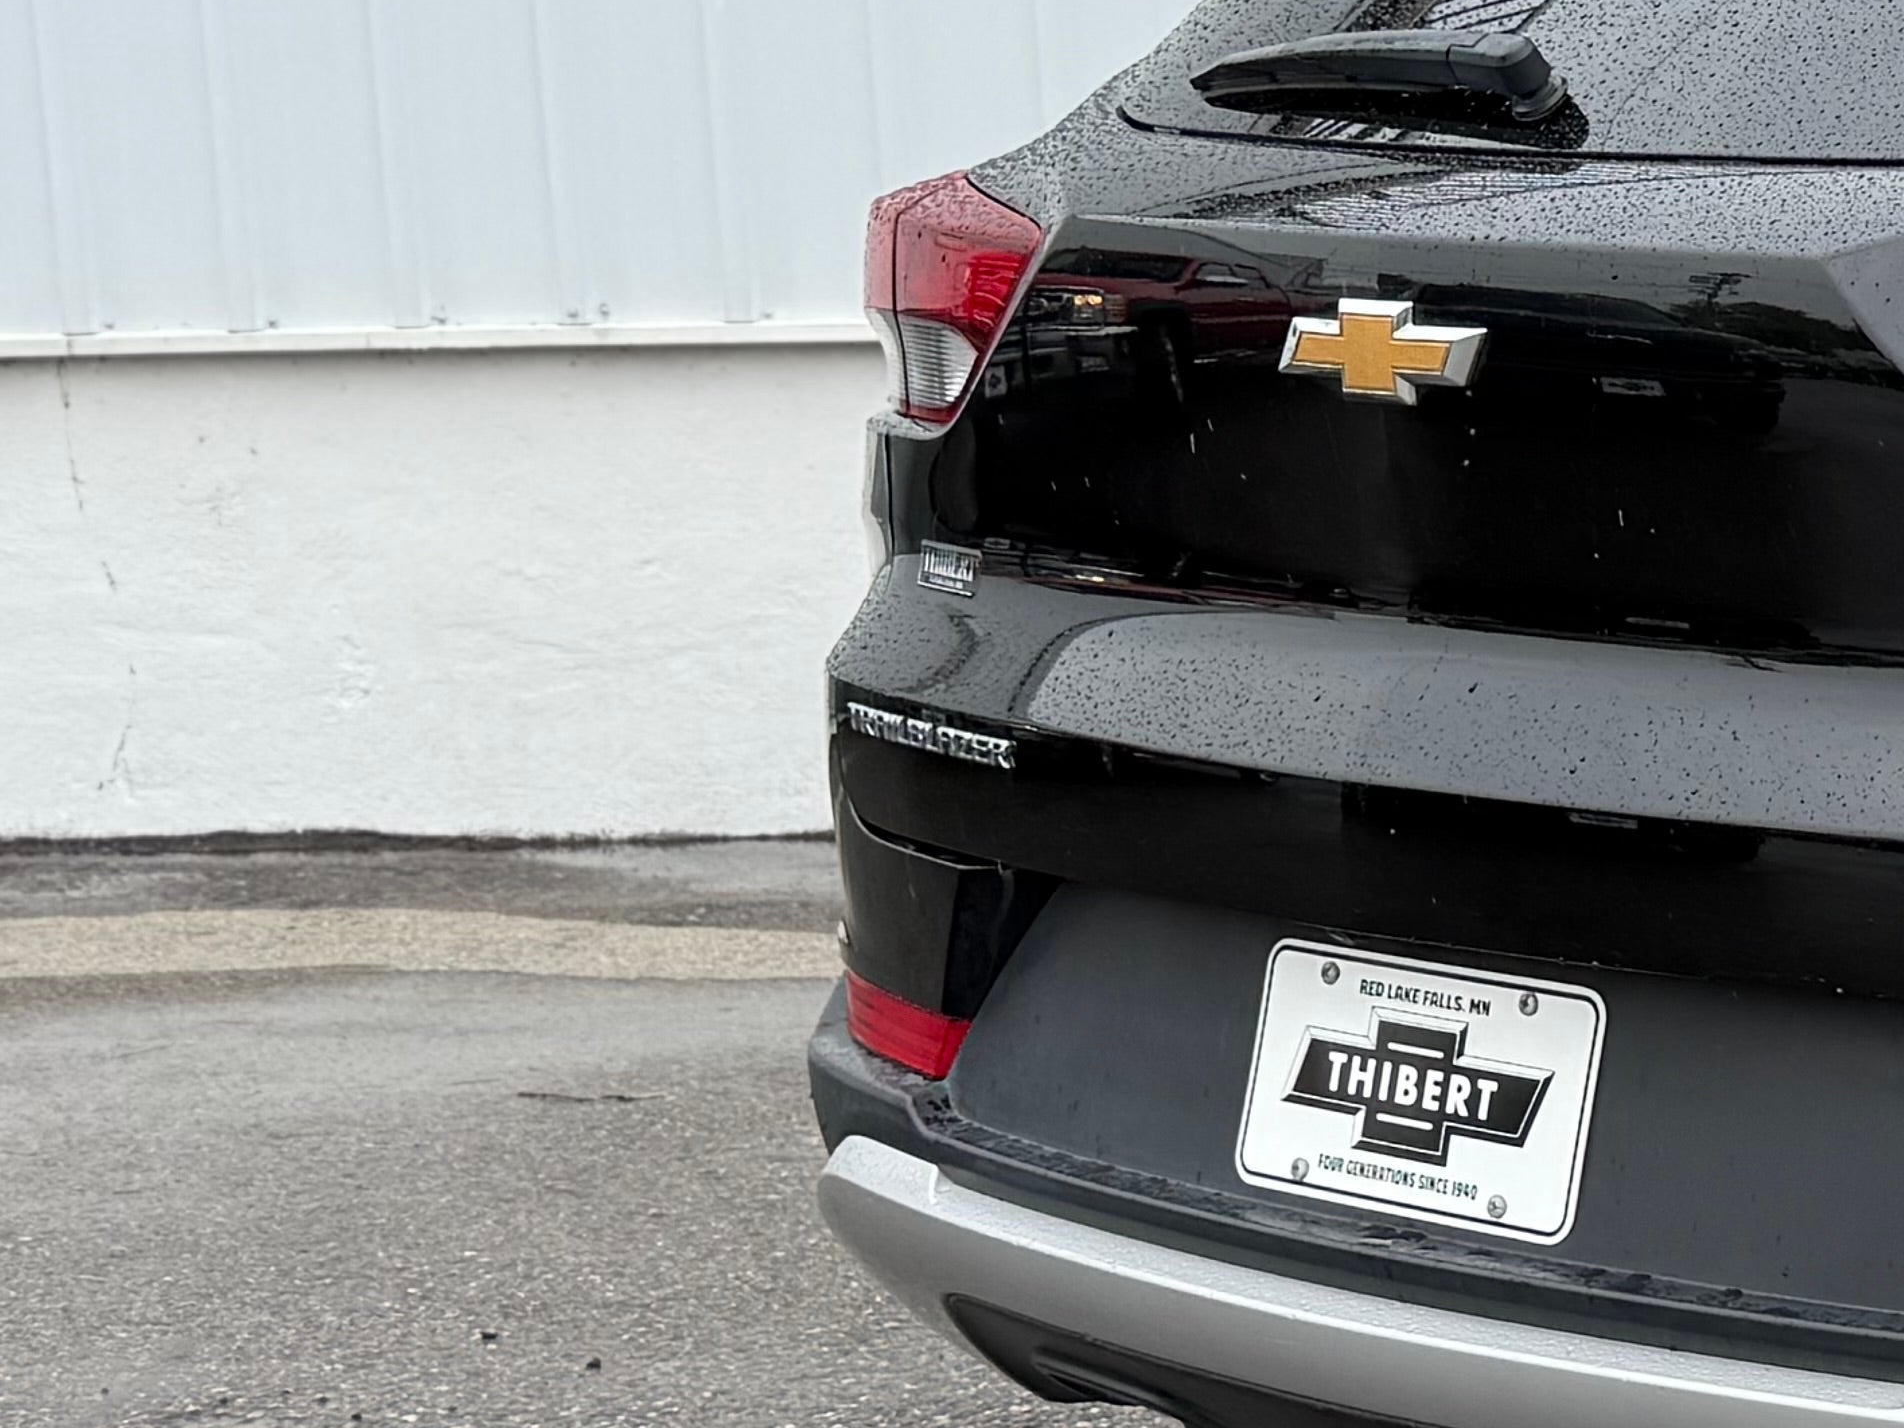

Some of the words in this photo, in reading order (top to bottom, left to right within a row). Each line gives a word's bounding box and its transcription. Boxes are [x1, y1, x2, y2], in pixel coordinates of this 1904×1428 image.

[1360, 978, 1385, 997] RED
[1387, 983, 1421, 1004] LAKE
[1468, 997, 1491, 1016] MN
[1327, 1050, 1499, 1122] THIBERT
[1318, 1153, 1345, 1173] FOUR
[1346, 1160, 1416, 1188] GENERATIONS
[1417, 1174, 1449, 1195] SINCE
